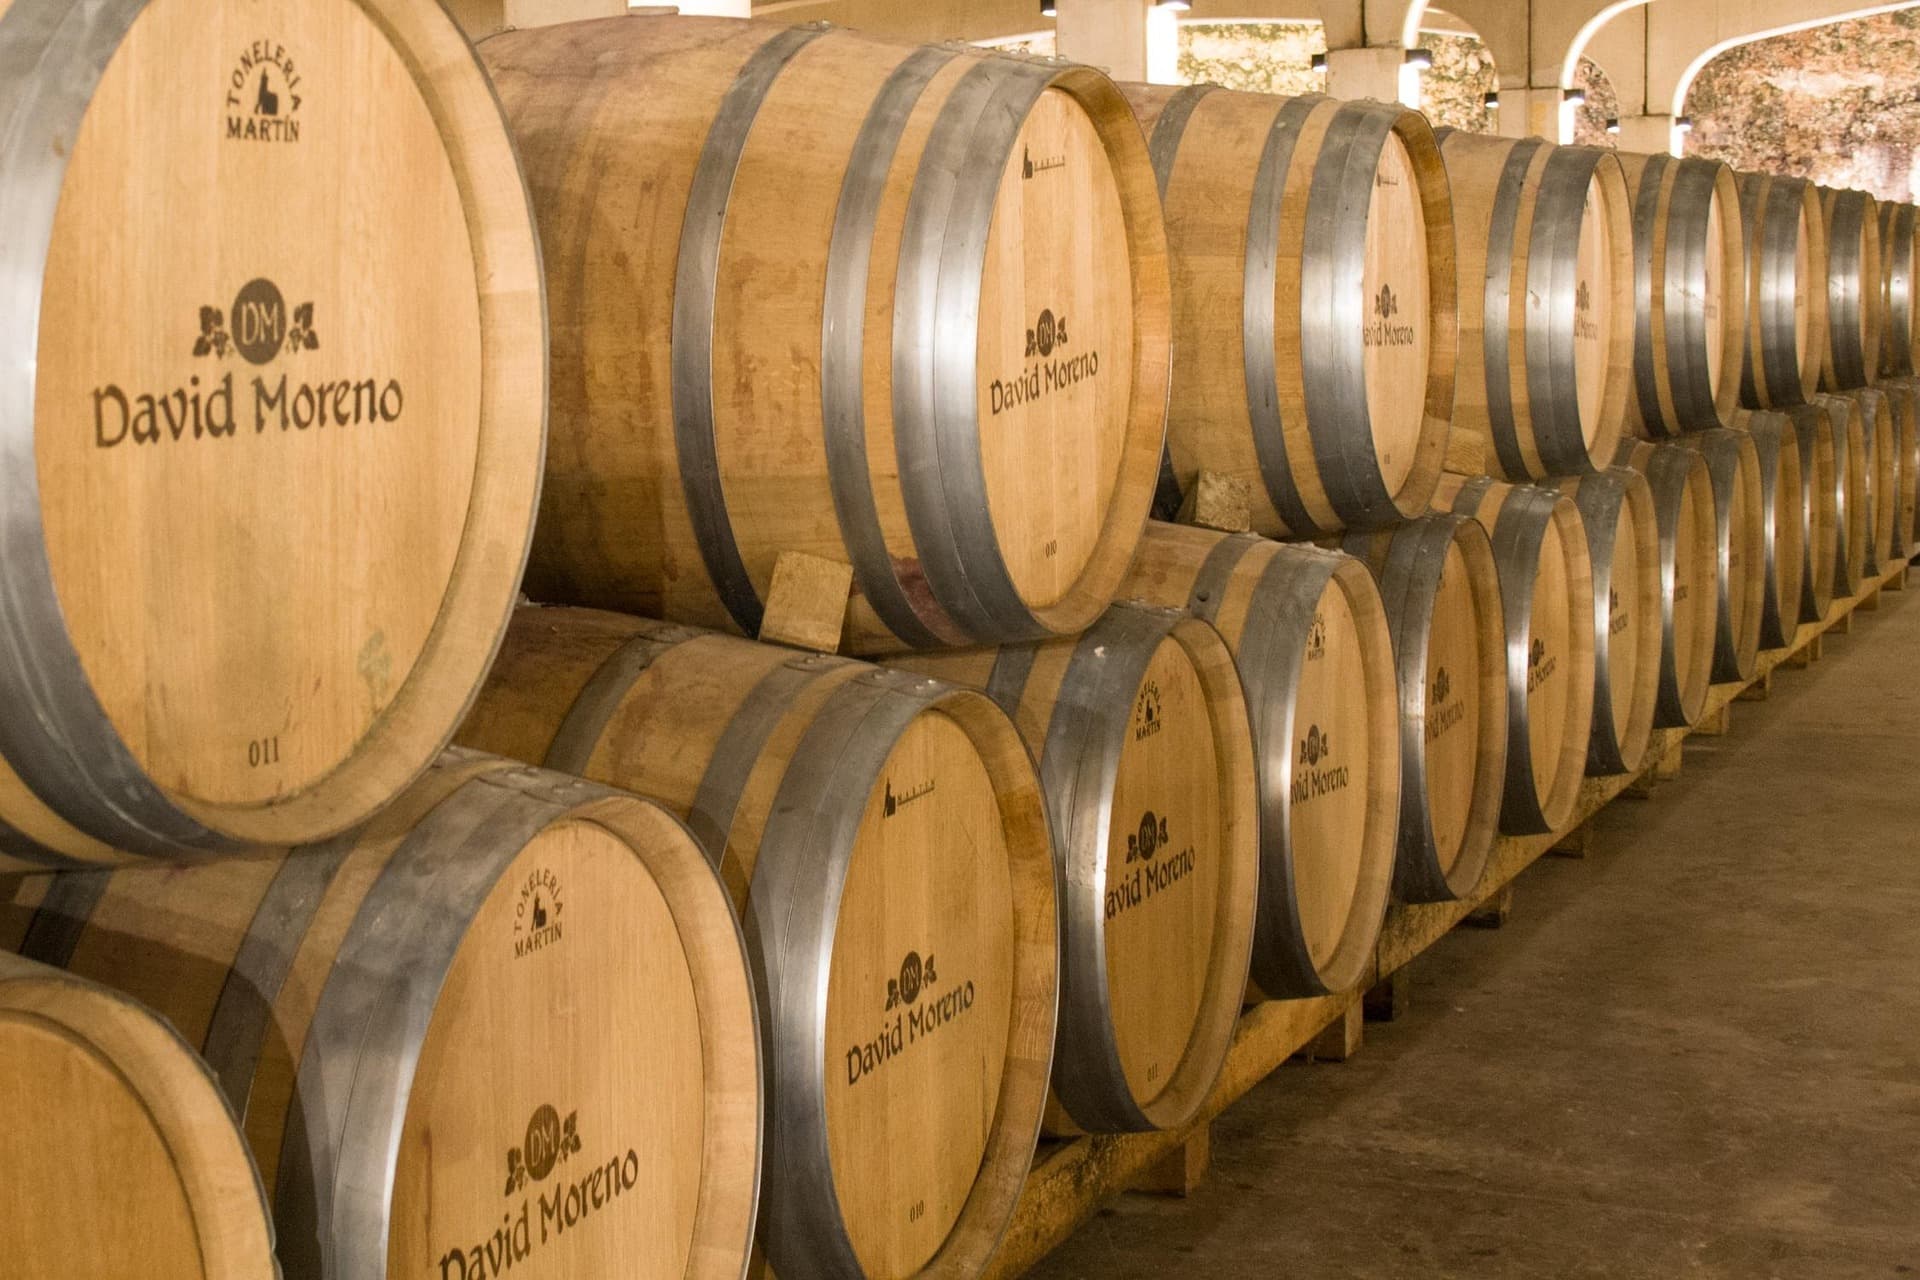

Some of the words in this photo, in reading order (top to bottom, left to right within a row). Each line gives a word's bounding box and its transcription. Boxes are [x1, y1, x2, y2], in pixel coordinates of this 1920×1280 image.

[241, 302, 280, 346] DM
[1362, 321, 1382, 347] avid
[93, 372, 236, 448] David
[252, 373, 404, 434] Moreno
[989, 362, 1040, 416] David
[1044, 358, 1098, 395] Moreno
[248, 735, 280, 768] 011
[1311, 766, 1349, 799] Moreno
[1104, 867, 1141, 920] avid
[1146, 845, 1196, 898] Moreno
[846, 1012, 903, 1087] David
[908, 980, 974, 1045] Moreno
[530, 1118, 556, 1168] DM
[538, 1148, 639, 1245] Moreno
[909, 1200, 925, 1223] 010
